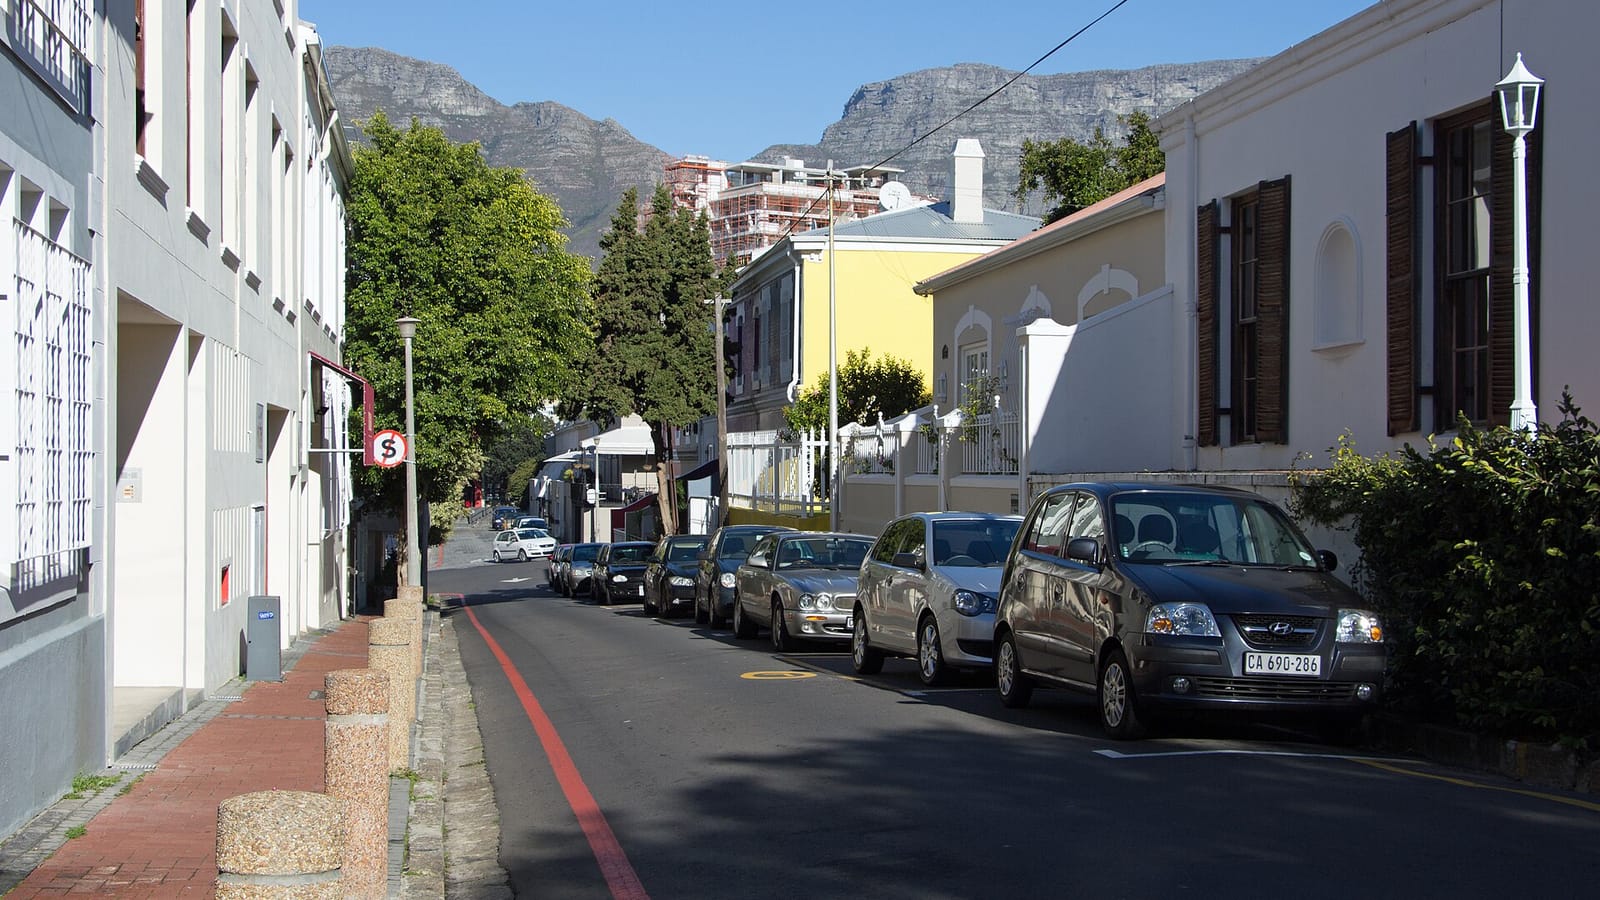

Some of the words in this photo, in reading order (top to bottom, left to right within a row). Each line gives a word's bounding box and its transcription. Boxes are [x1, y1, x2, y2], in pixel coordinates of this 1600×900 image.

[381, 438, 397, 459] S
[1247, 654, 1263, 670] CA
[1267, 655, 1318, 672] 690-286
